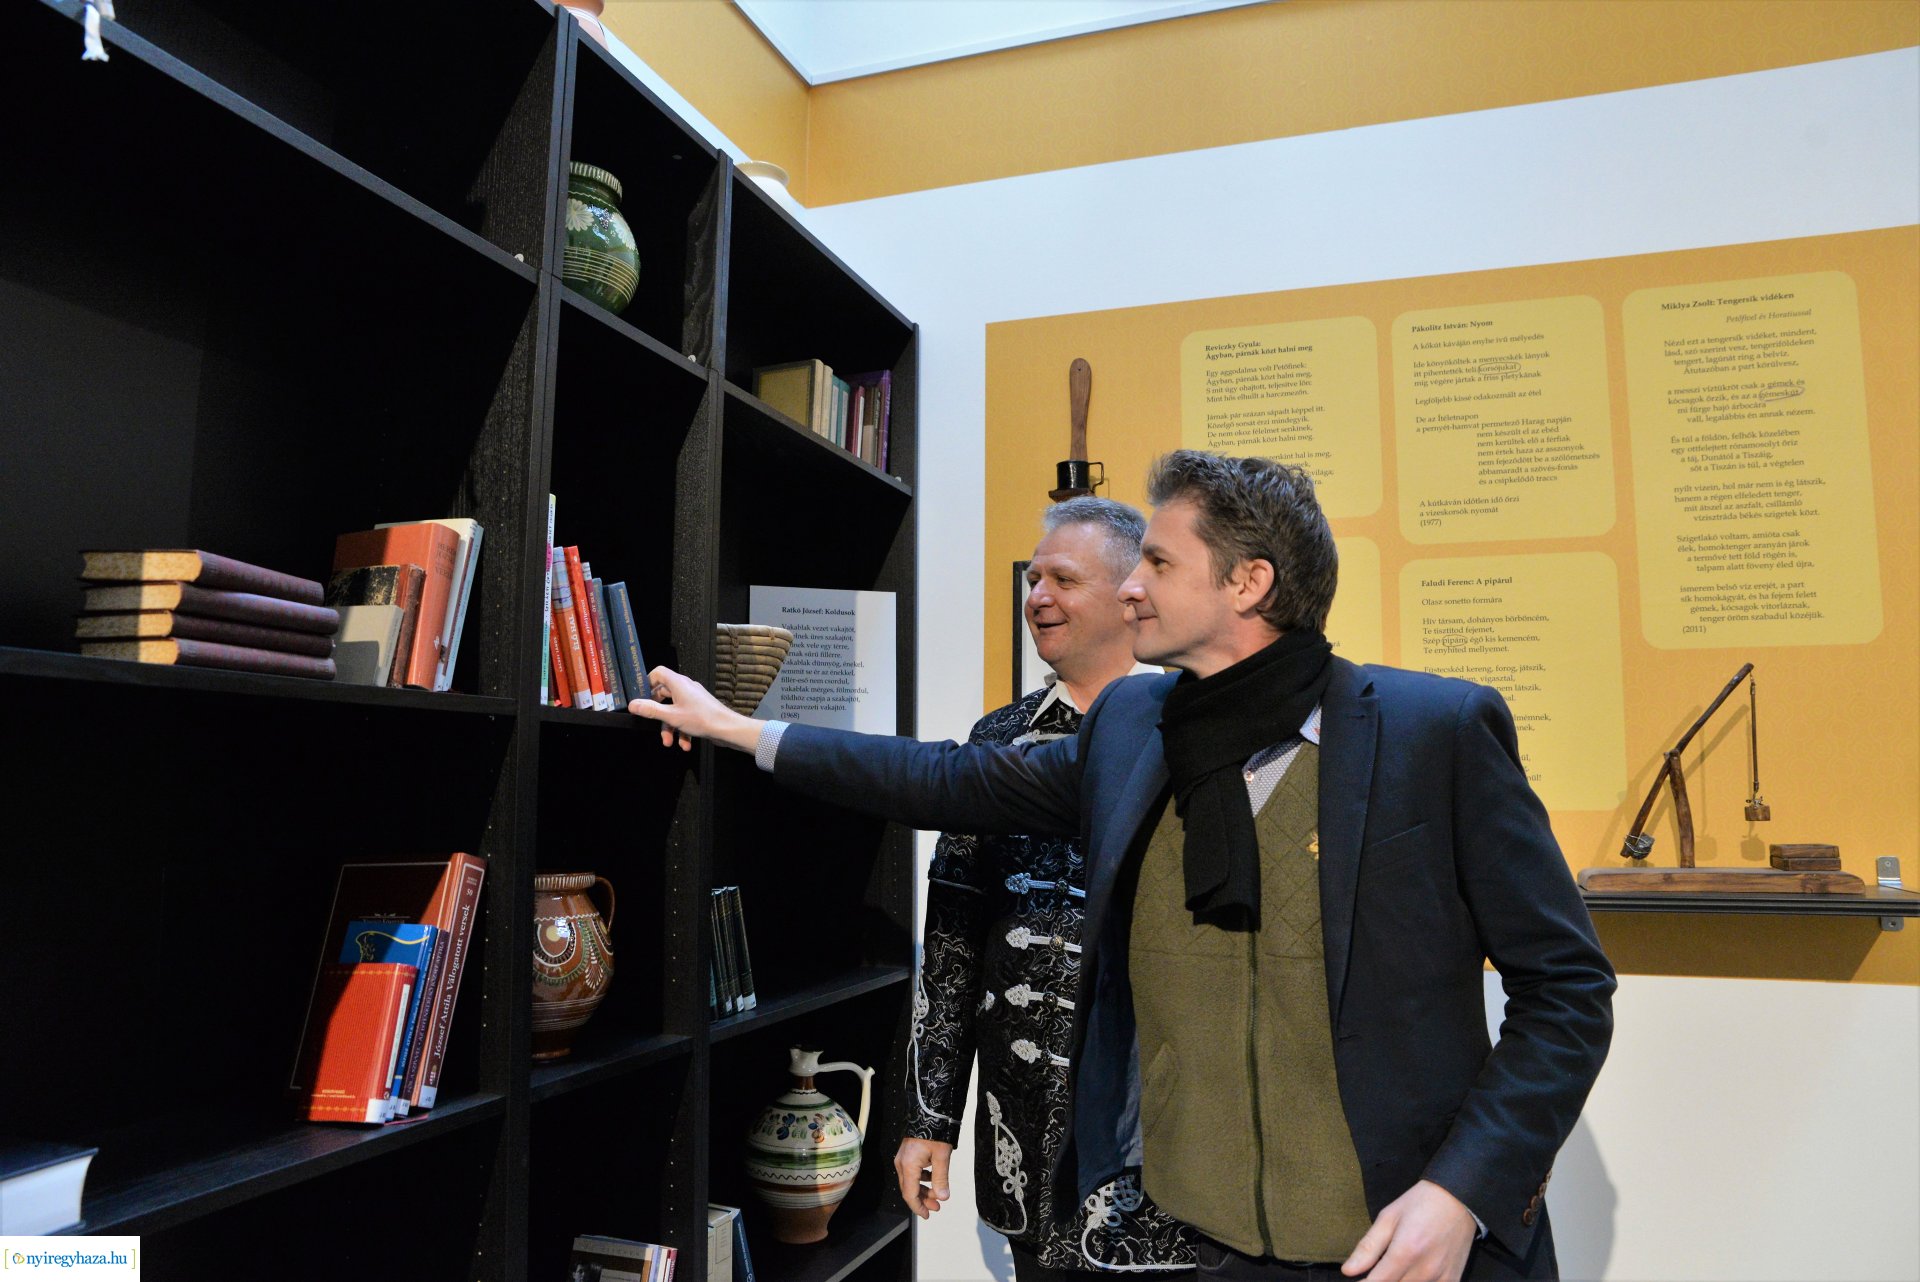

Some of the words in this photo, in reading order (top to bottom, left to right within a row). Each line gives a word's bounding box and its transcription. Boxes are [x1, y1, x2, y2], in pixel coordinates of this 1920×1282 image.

[1421, 579, 1446, 587] Faludi
[1484, 577, 1513, 587] pipárul
[569, 614, 577, 633] HAL
[434, 1023, 446, 1059] József
[440, 994, 452, 1020] Attila
[446, 938, 464, 992] Válogatott
[460, 904, 471, 938] versek
